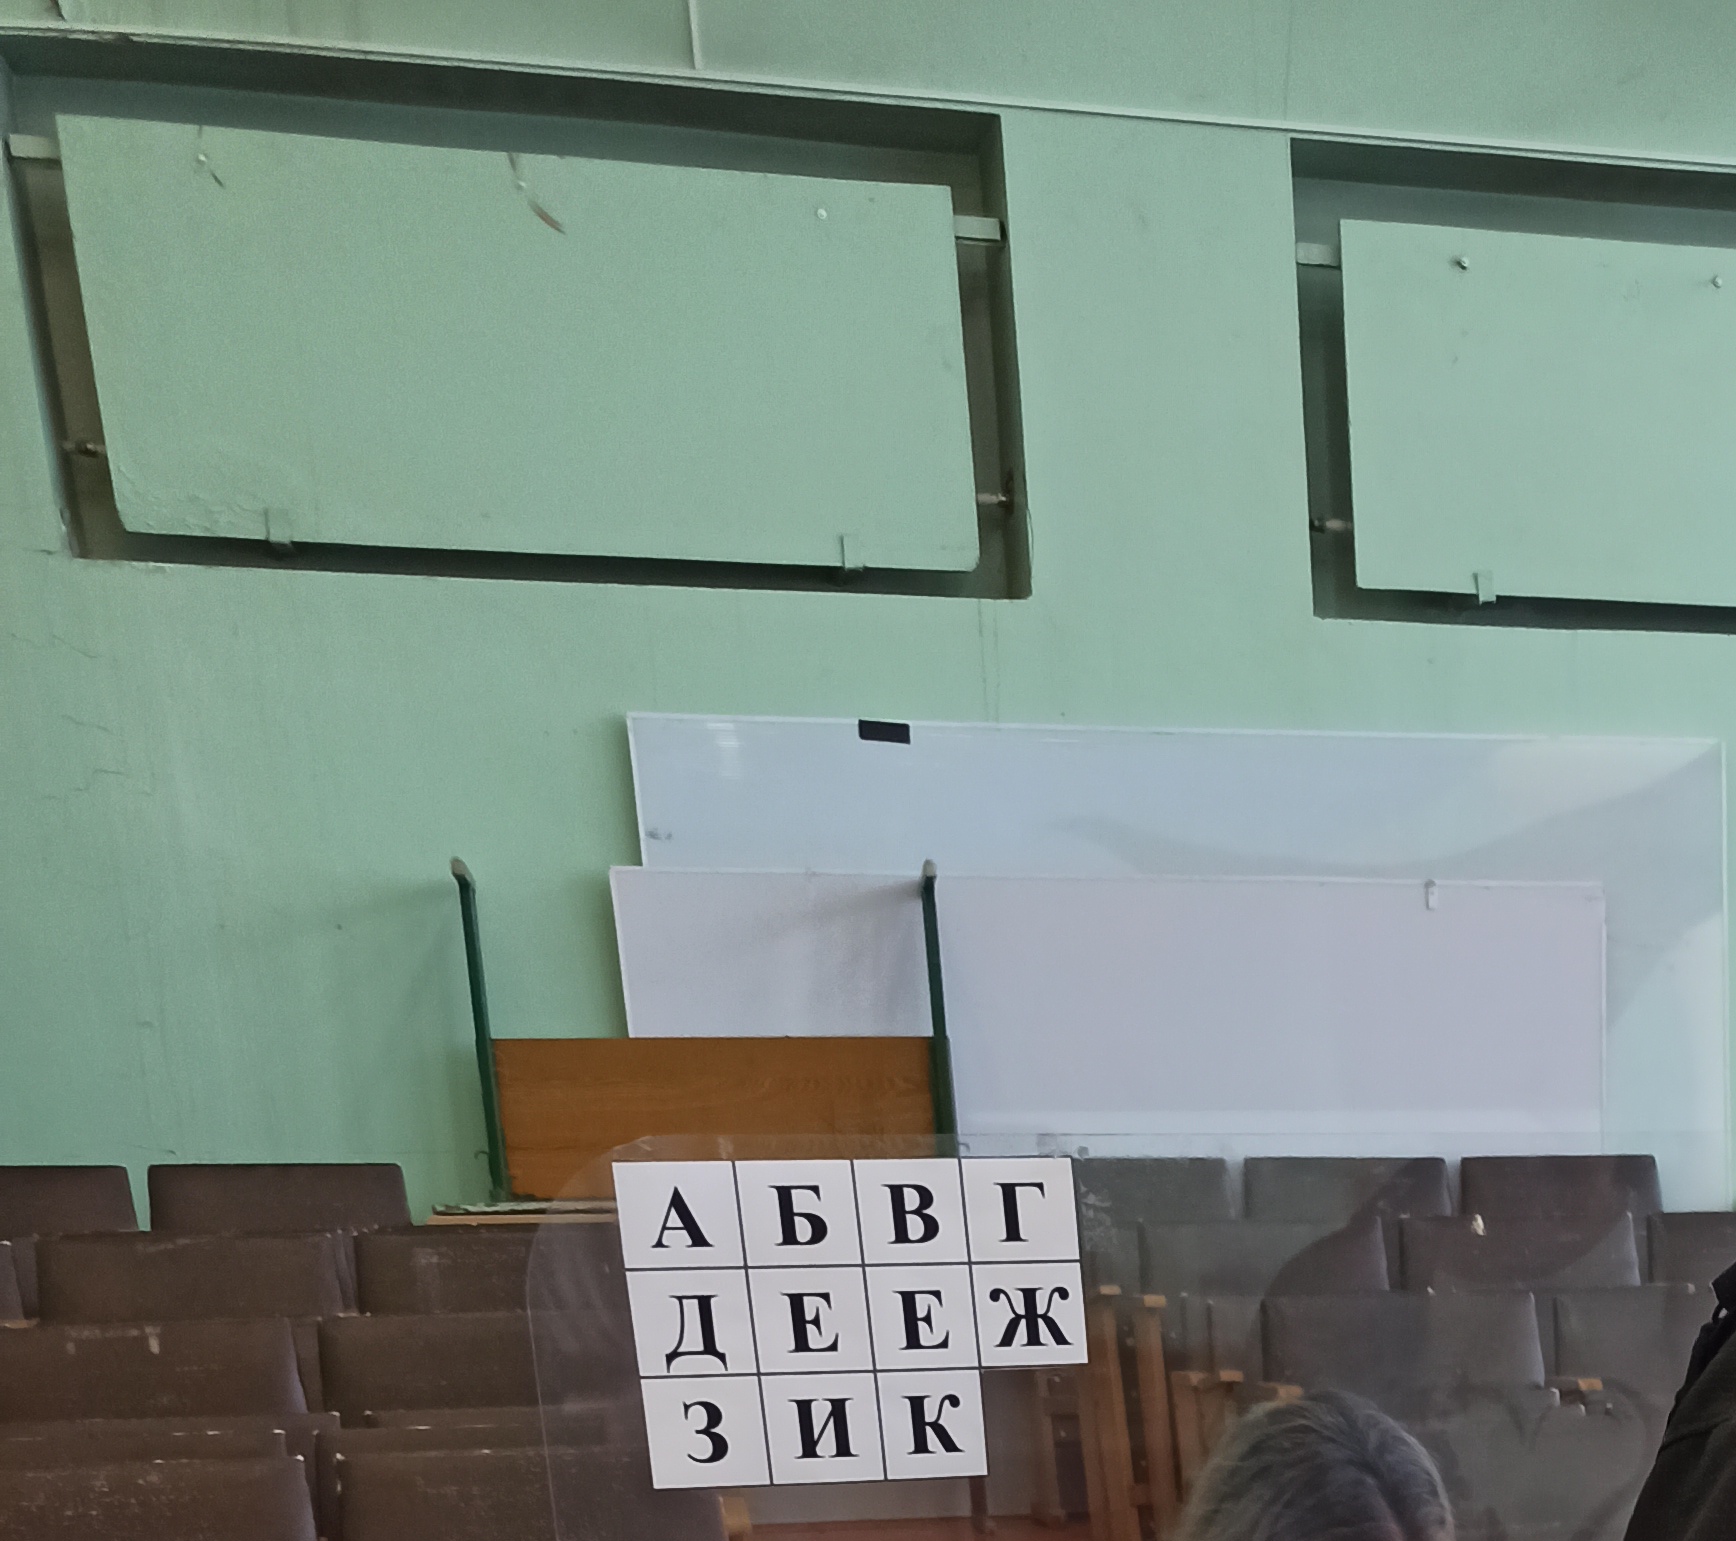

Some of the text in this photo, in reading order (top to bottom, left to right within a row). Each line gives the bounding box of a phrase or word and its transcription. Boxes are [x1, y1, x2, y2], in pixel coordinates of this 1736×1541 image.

[651, 1181, 1046, 1249] А Б В Г
[664, 1286, 1074, 1374] Д Е Е Ж
[682, 1393, 965, 1464] З И К
